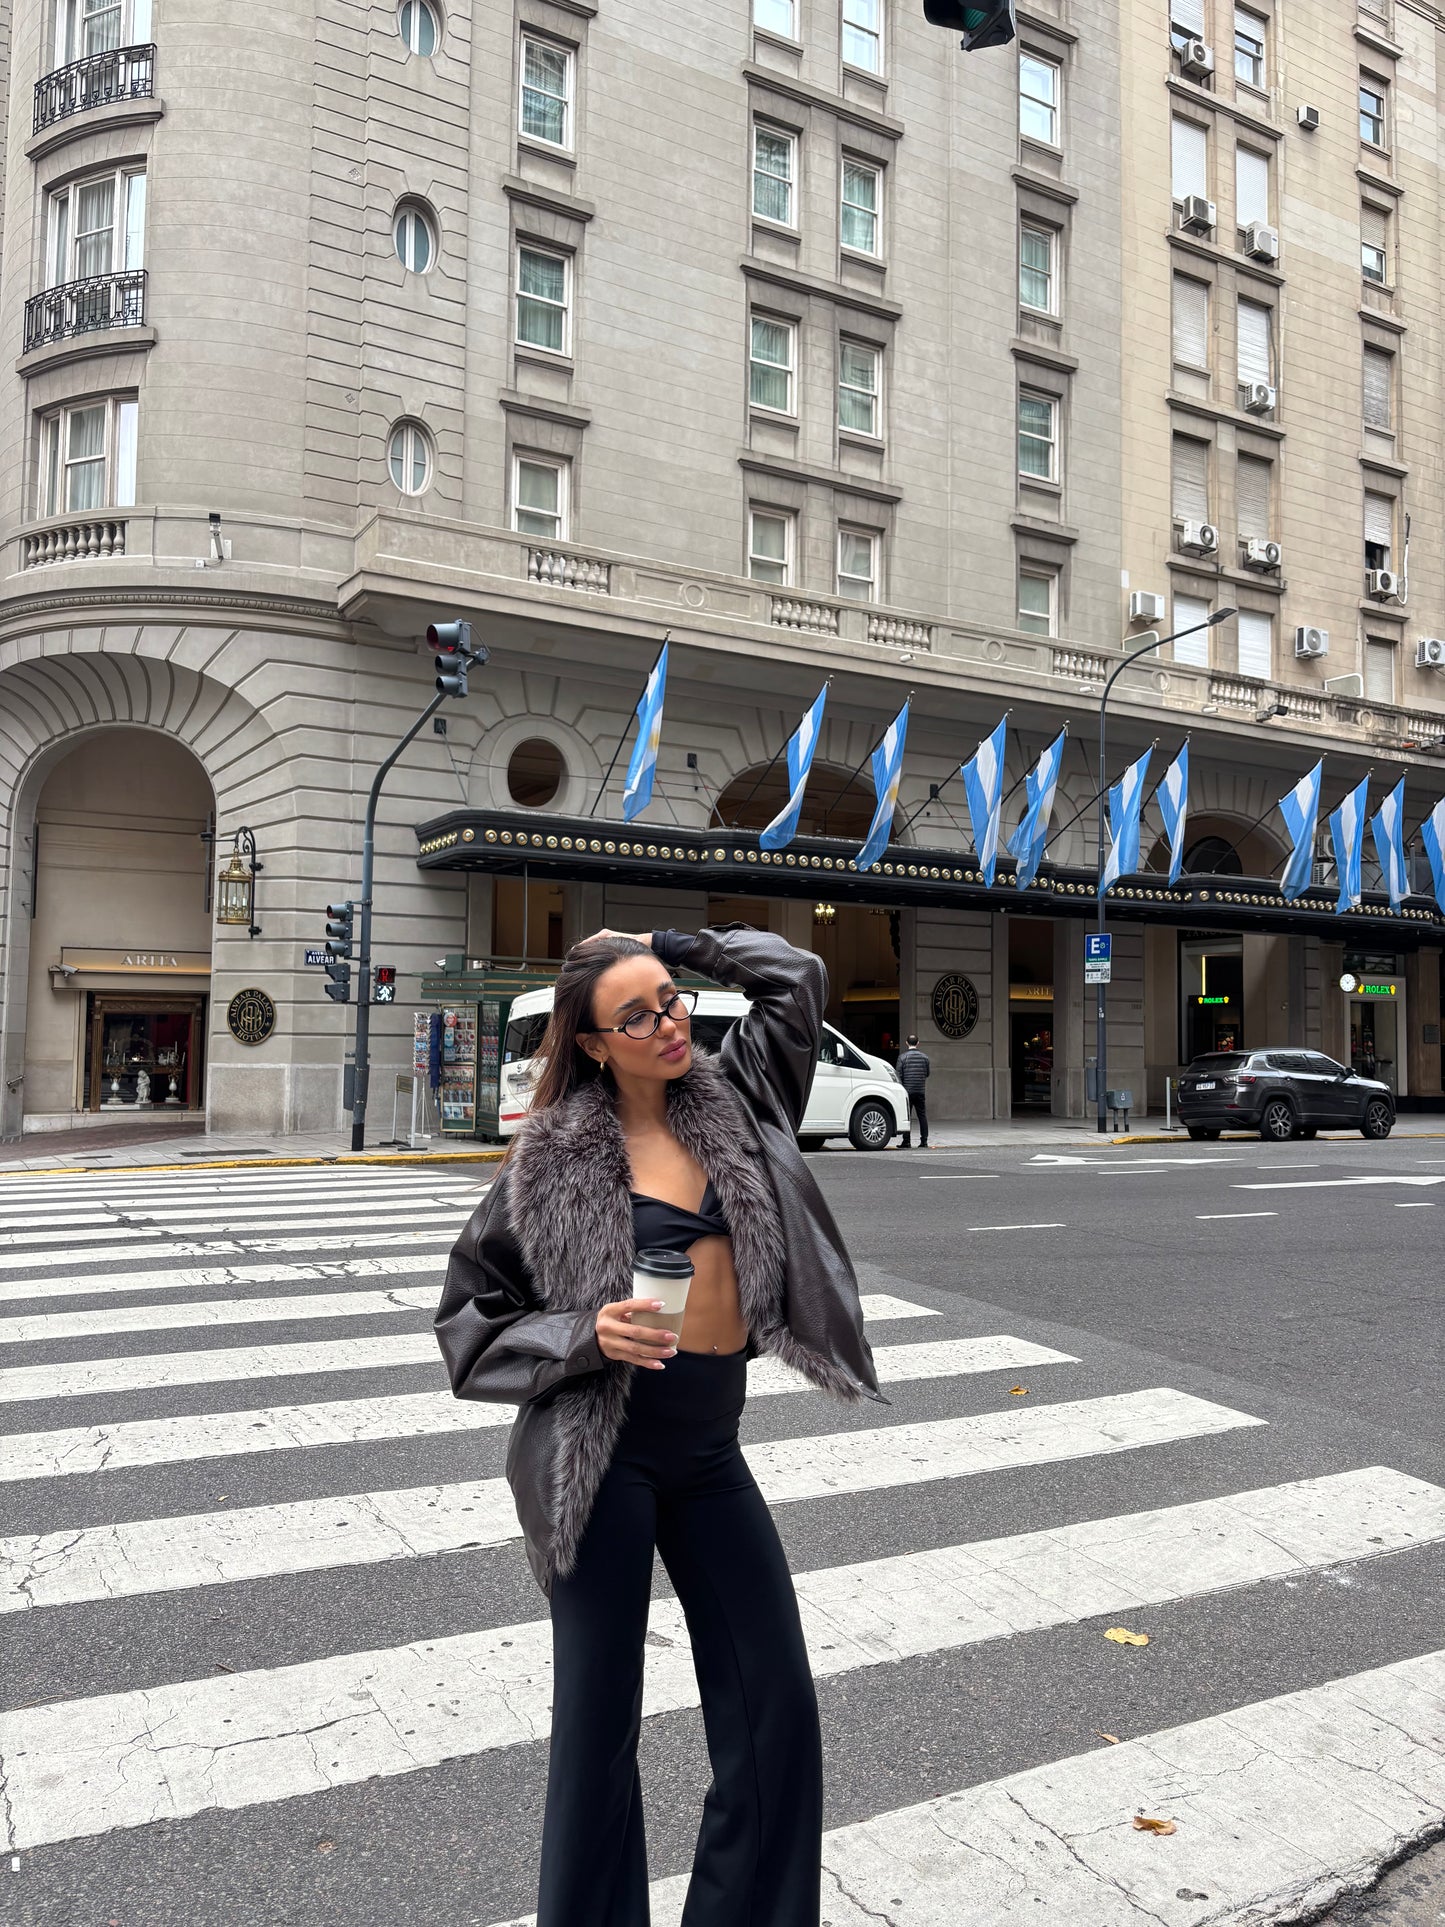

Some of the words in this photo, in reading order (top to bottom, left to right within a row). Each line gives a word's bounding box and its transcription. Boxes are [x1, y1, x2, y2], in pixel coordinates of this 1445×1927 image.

[1091, 937, 1101, 955] E
[307, 955, 334, 964] ALVEAR
[1365, 984, 1390, 994] ROLEX
[230, 990, 252, 1018] ALVEAR
[253, 990, 273, 1018] PALACE
[236, 1029, 266, 1042] HOTEL
[941, 1021, 971, 1036] HOTEL
